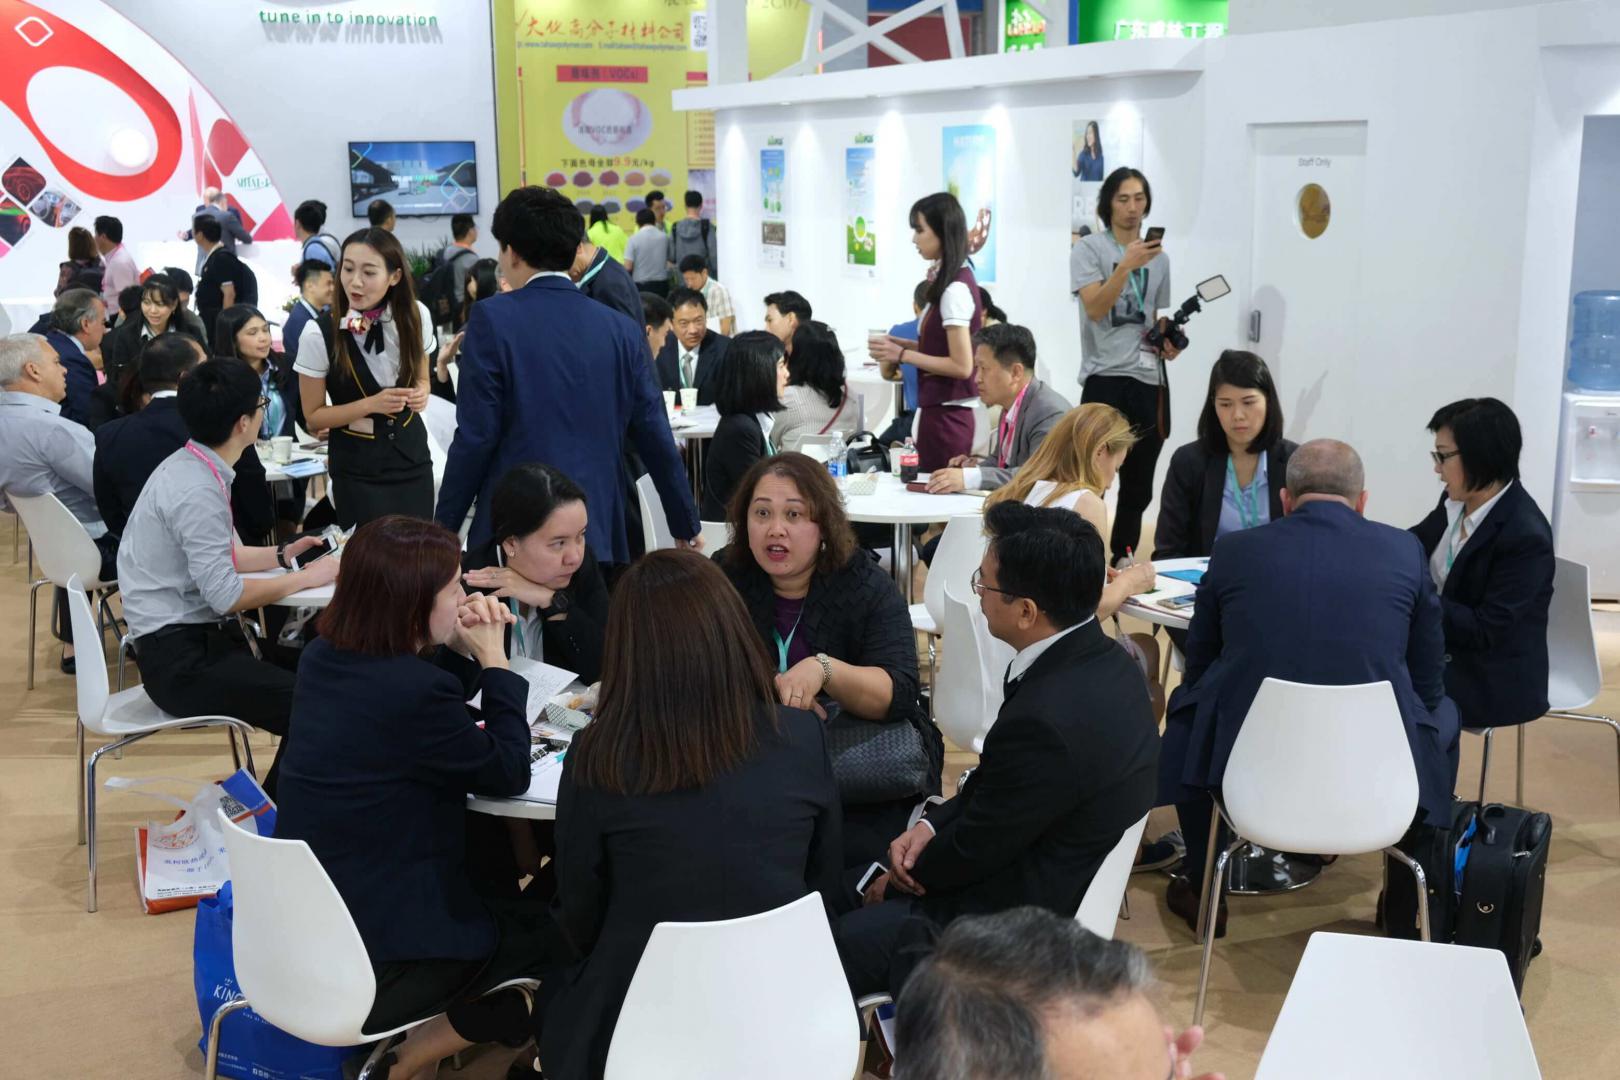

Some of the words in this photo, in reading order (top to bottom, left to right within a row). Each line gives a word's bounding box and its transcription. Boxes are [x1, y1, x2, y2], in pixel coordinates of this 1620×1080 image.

[259, 11, 300, 24] tune
[306, 10, 321, 24] in
[327, 12, 344, 24] to
[349, 11, 437, 26] innovation
[1315, 158, 1332, 168] Only
